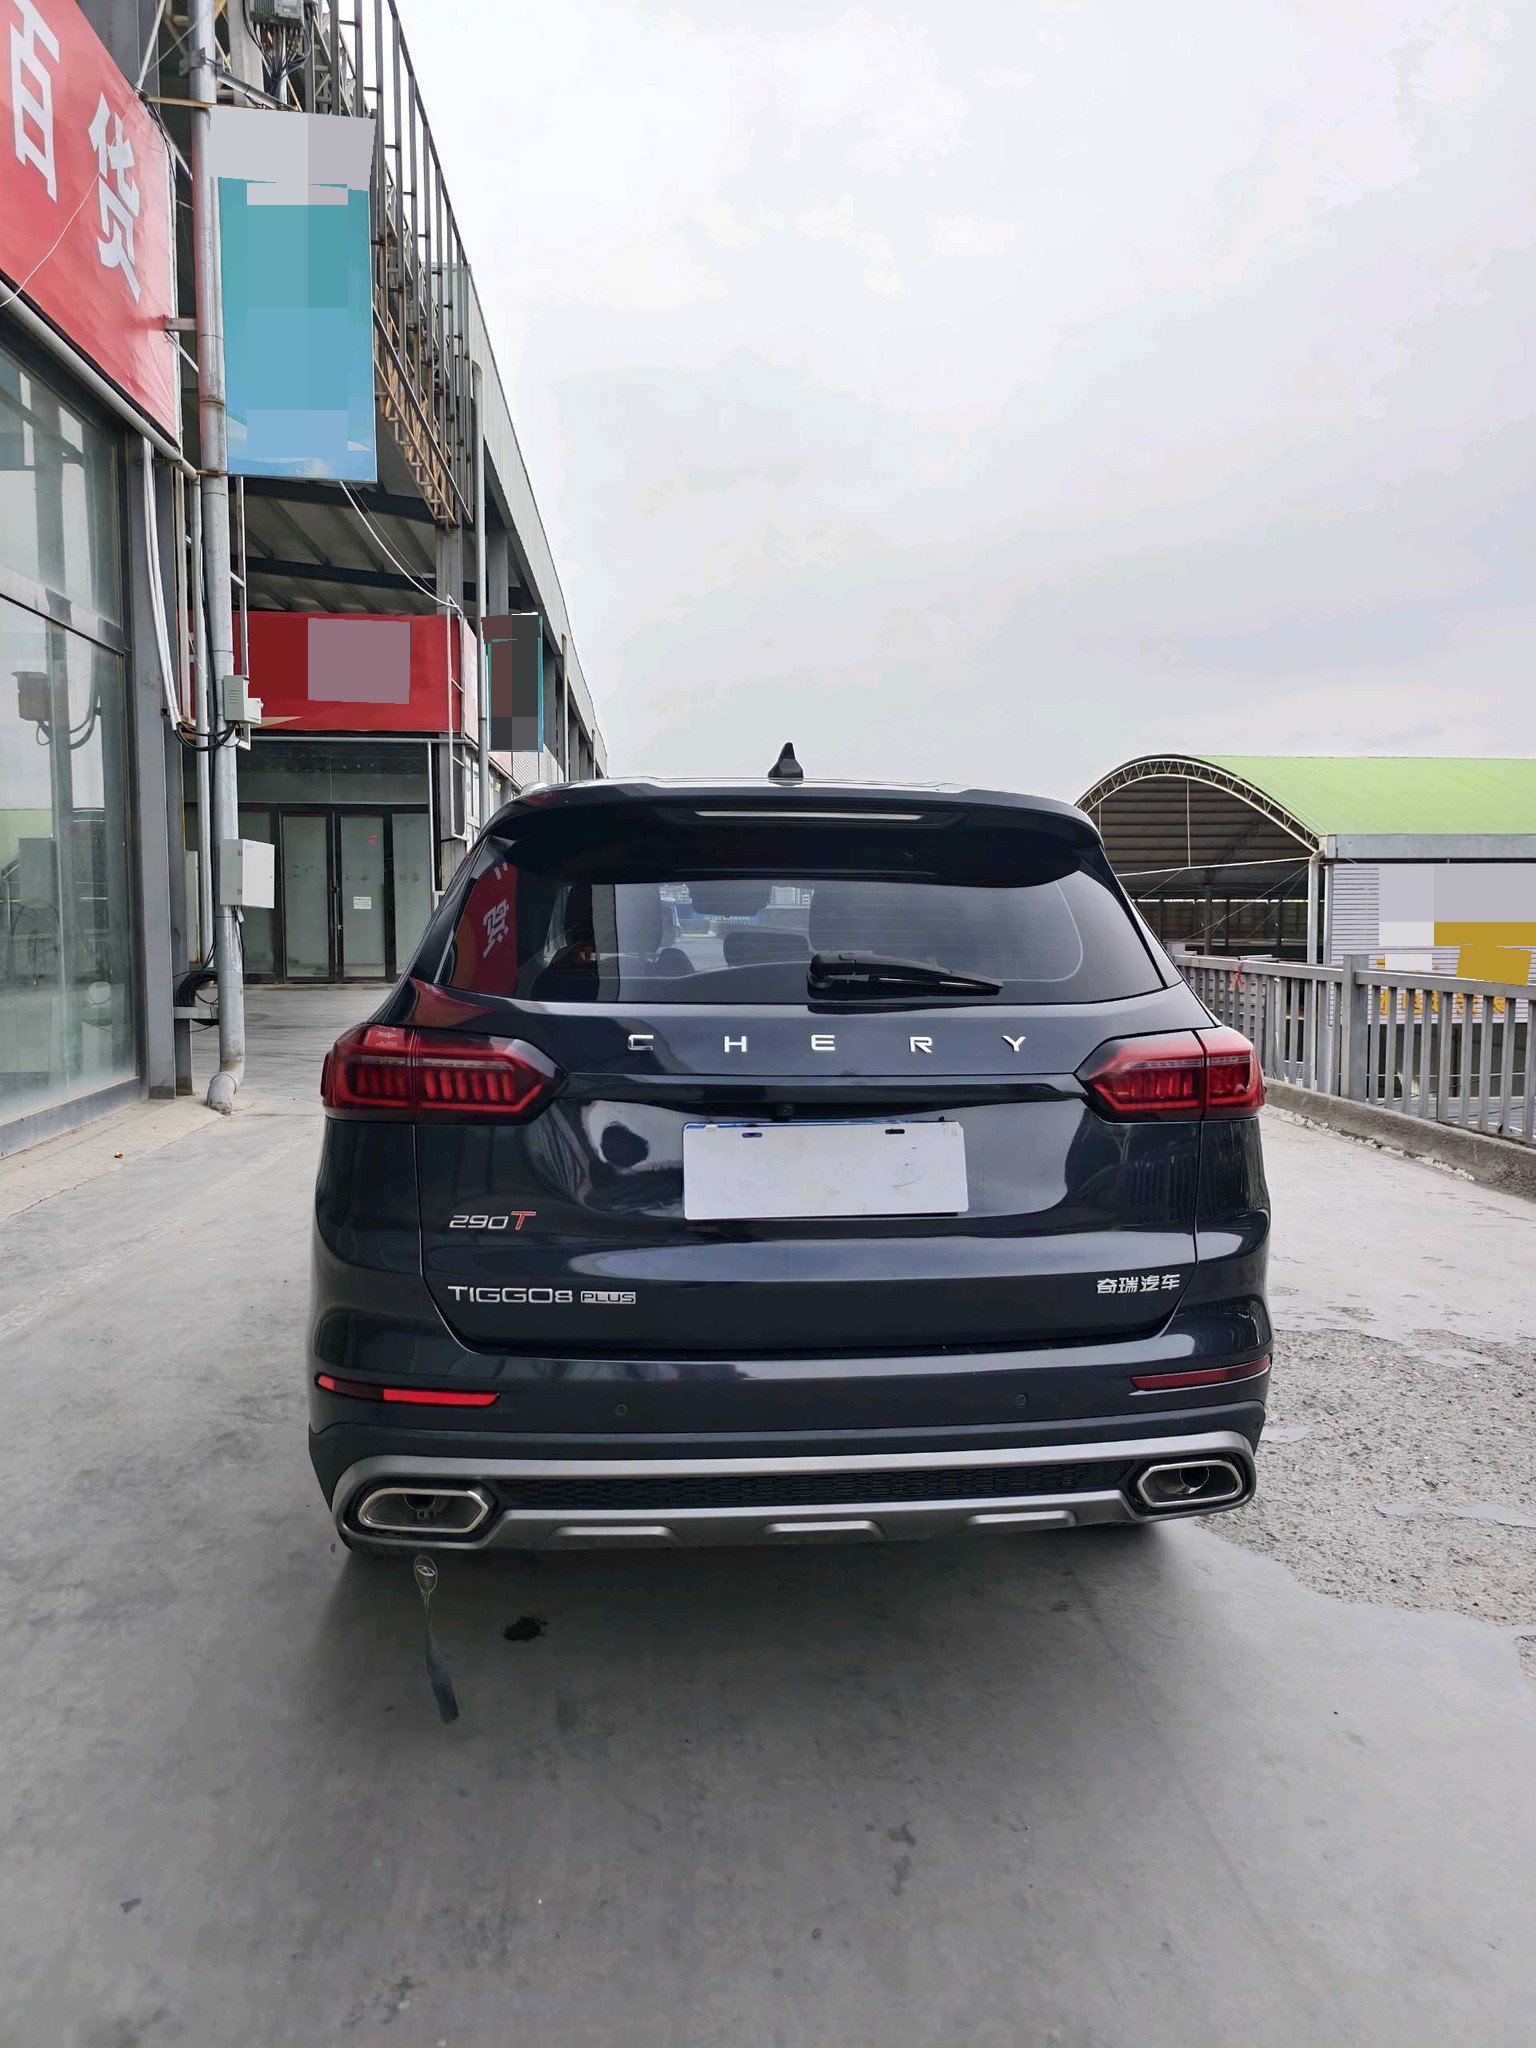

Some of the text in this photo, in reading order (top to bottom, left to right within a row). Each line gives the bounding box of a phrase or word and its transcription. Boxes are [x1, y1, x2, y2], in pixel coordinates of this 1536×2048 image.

[10, 0, 141, 304] 百货
[627, 1033, 1027, 1054] CHERY
[448, 1210, 537, 1231] 290T
[1096, 1273, 1181, 1295] 奇瑞汽车
[447, 1285, 637, 1305] TIGGO8 PLUS
